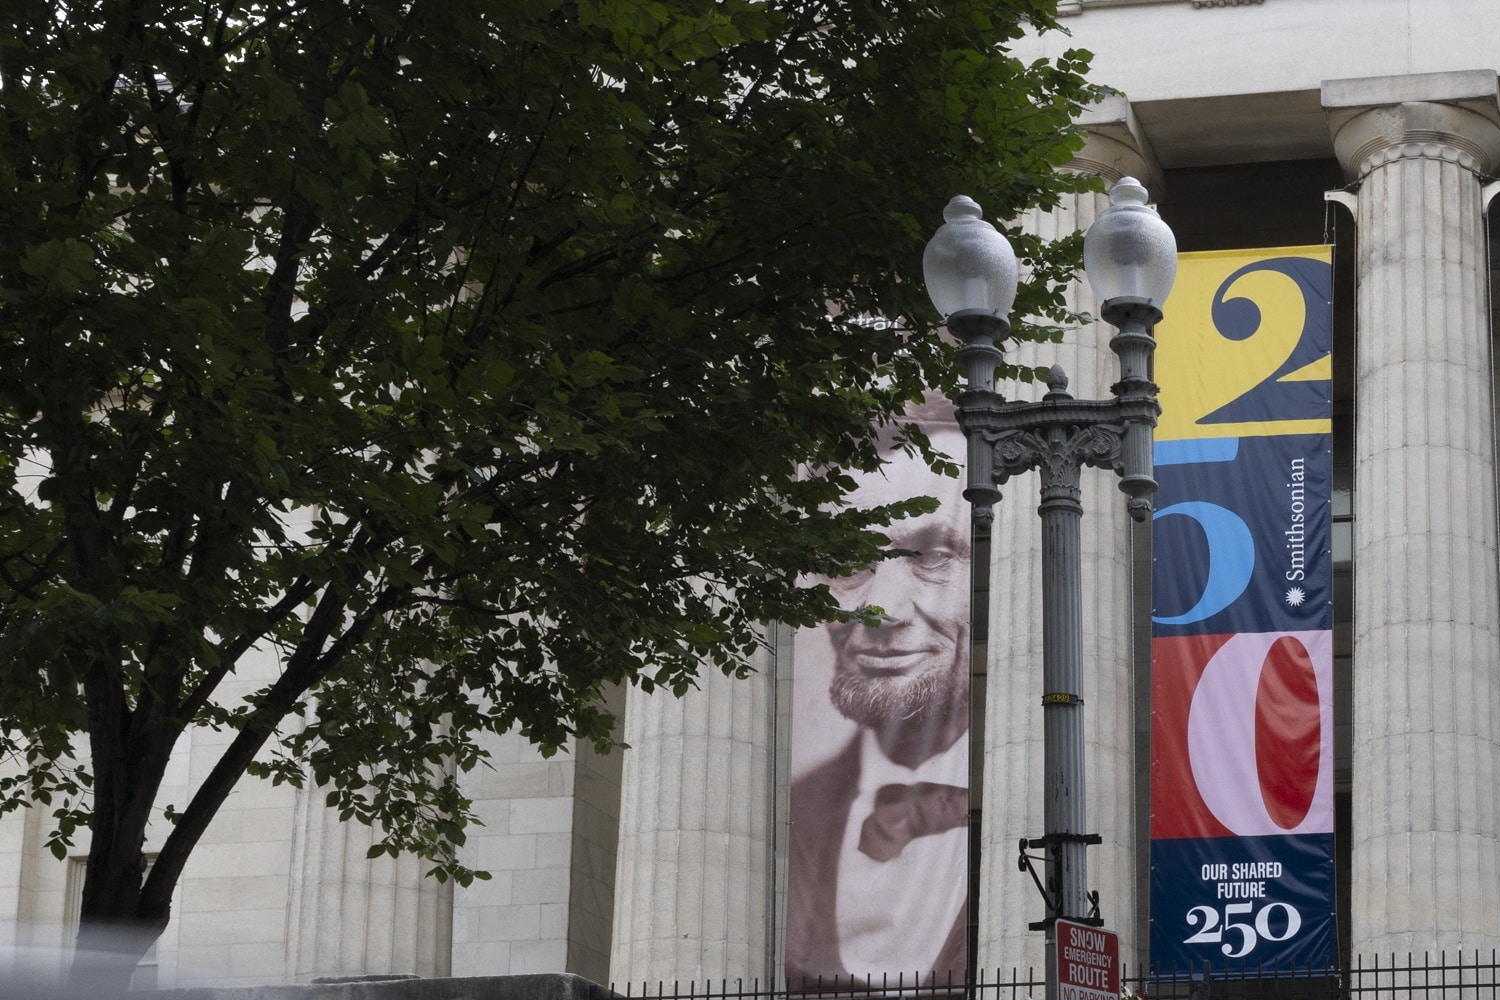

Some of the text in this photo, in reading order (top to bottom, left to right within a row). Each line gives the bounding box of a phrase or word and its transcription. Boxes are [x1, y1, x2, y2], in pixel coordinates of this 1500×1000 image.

[1284, 457, 1305, 582] Smithsonian
[1201, 861, 1283, 881] OUR SHARED
[1217, 881, 1266, 899] FUTURE
[1070, 927, 1106, 953] SNOW
[1182, 900, 1302, 958] 250
[1064, 946, 1112, 969] EMERGENCY
[1069, 962, 1109, 989] ROUTE
